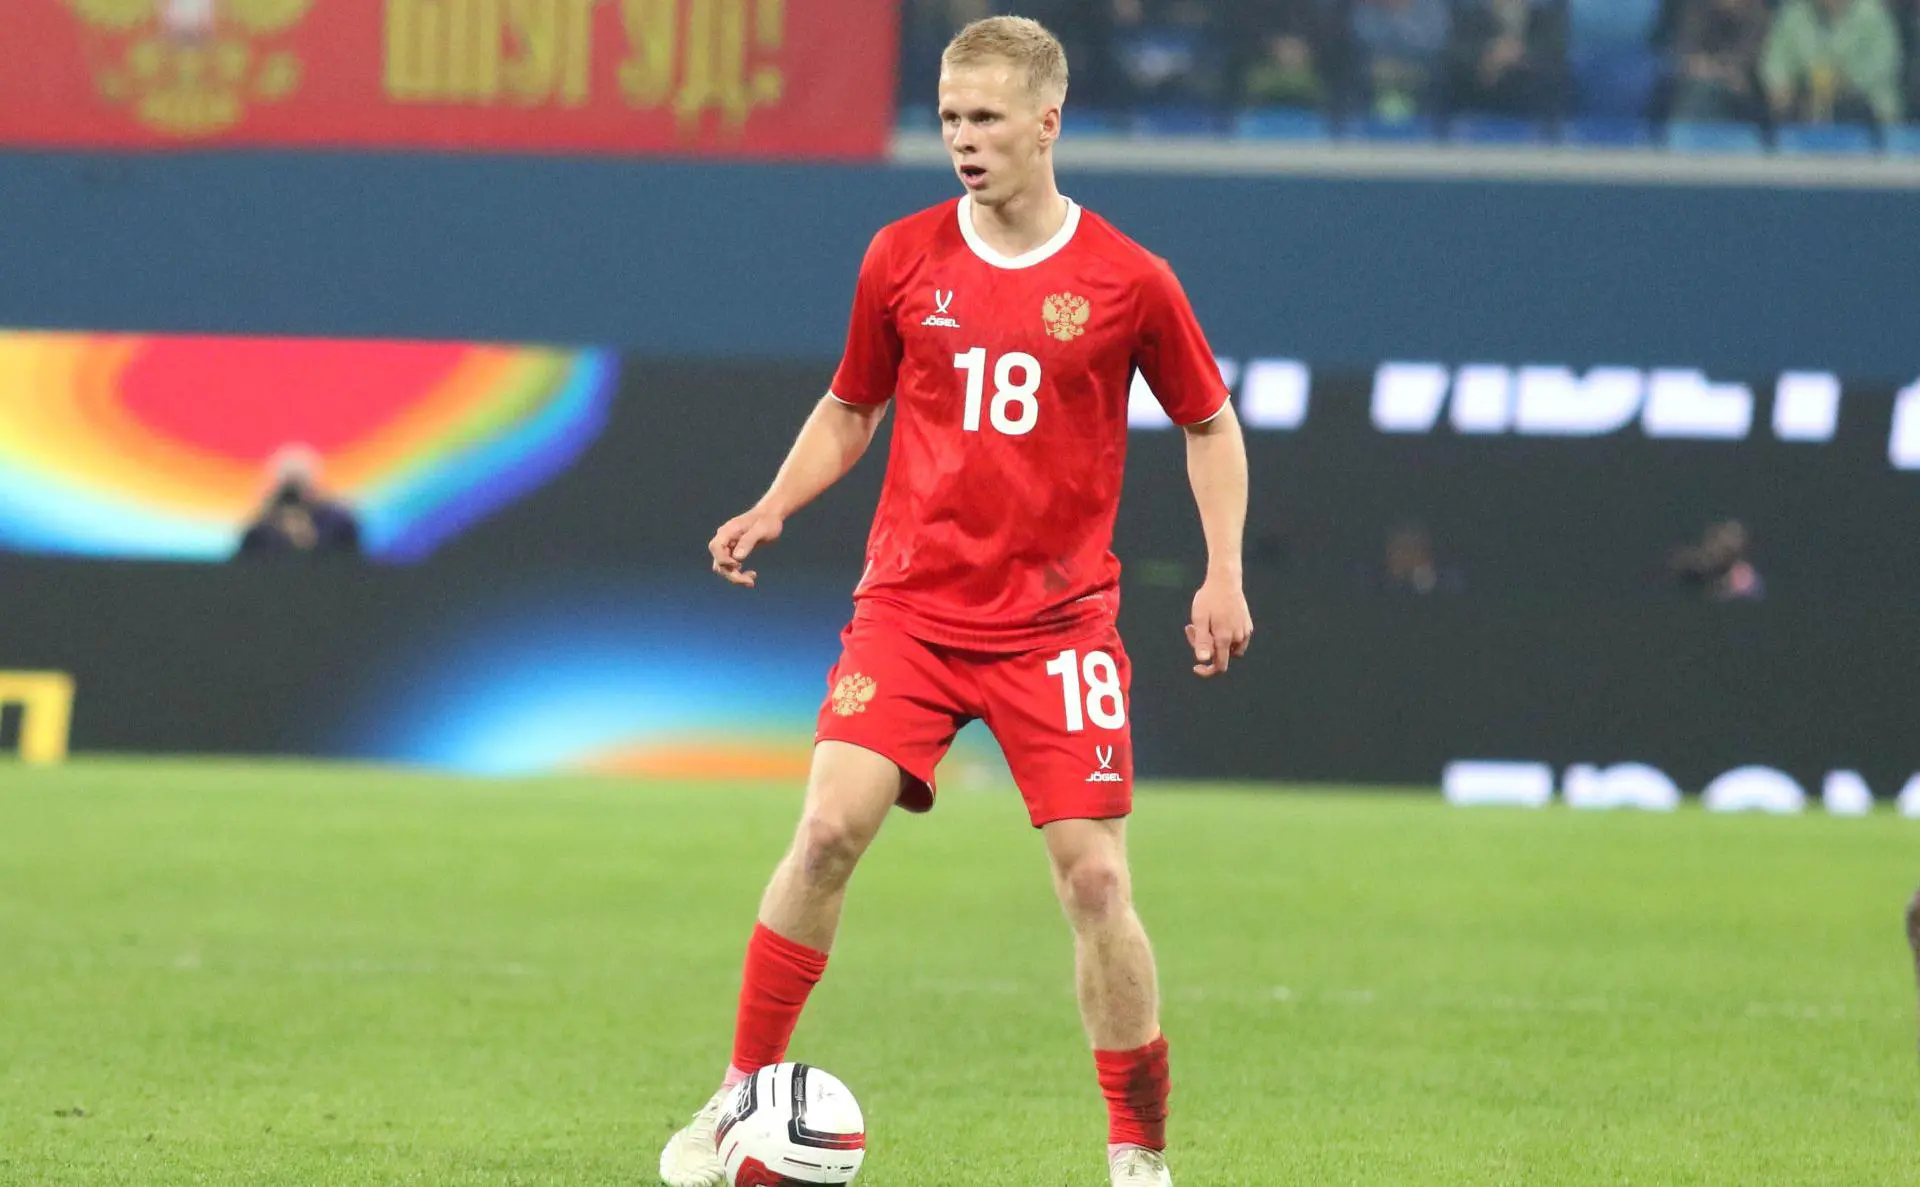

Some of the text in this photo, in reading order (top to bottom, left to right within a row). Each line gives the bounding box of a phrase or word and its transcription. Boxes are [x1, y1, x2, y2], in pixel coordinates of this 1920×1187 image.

[921, 315, 960, 328] JÖGEL
[953, 347, 1042, 435] 18
[1046, 649, 1126, 732] 18
[1085, 771, 1124, 782] JÖGEL
